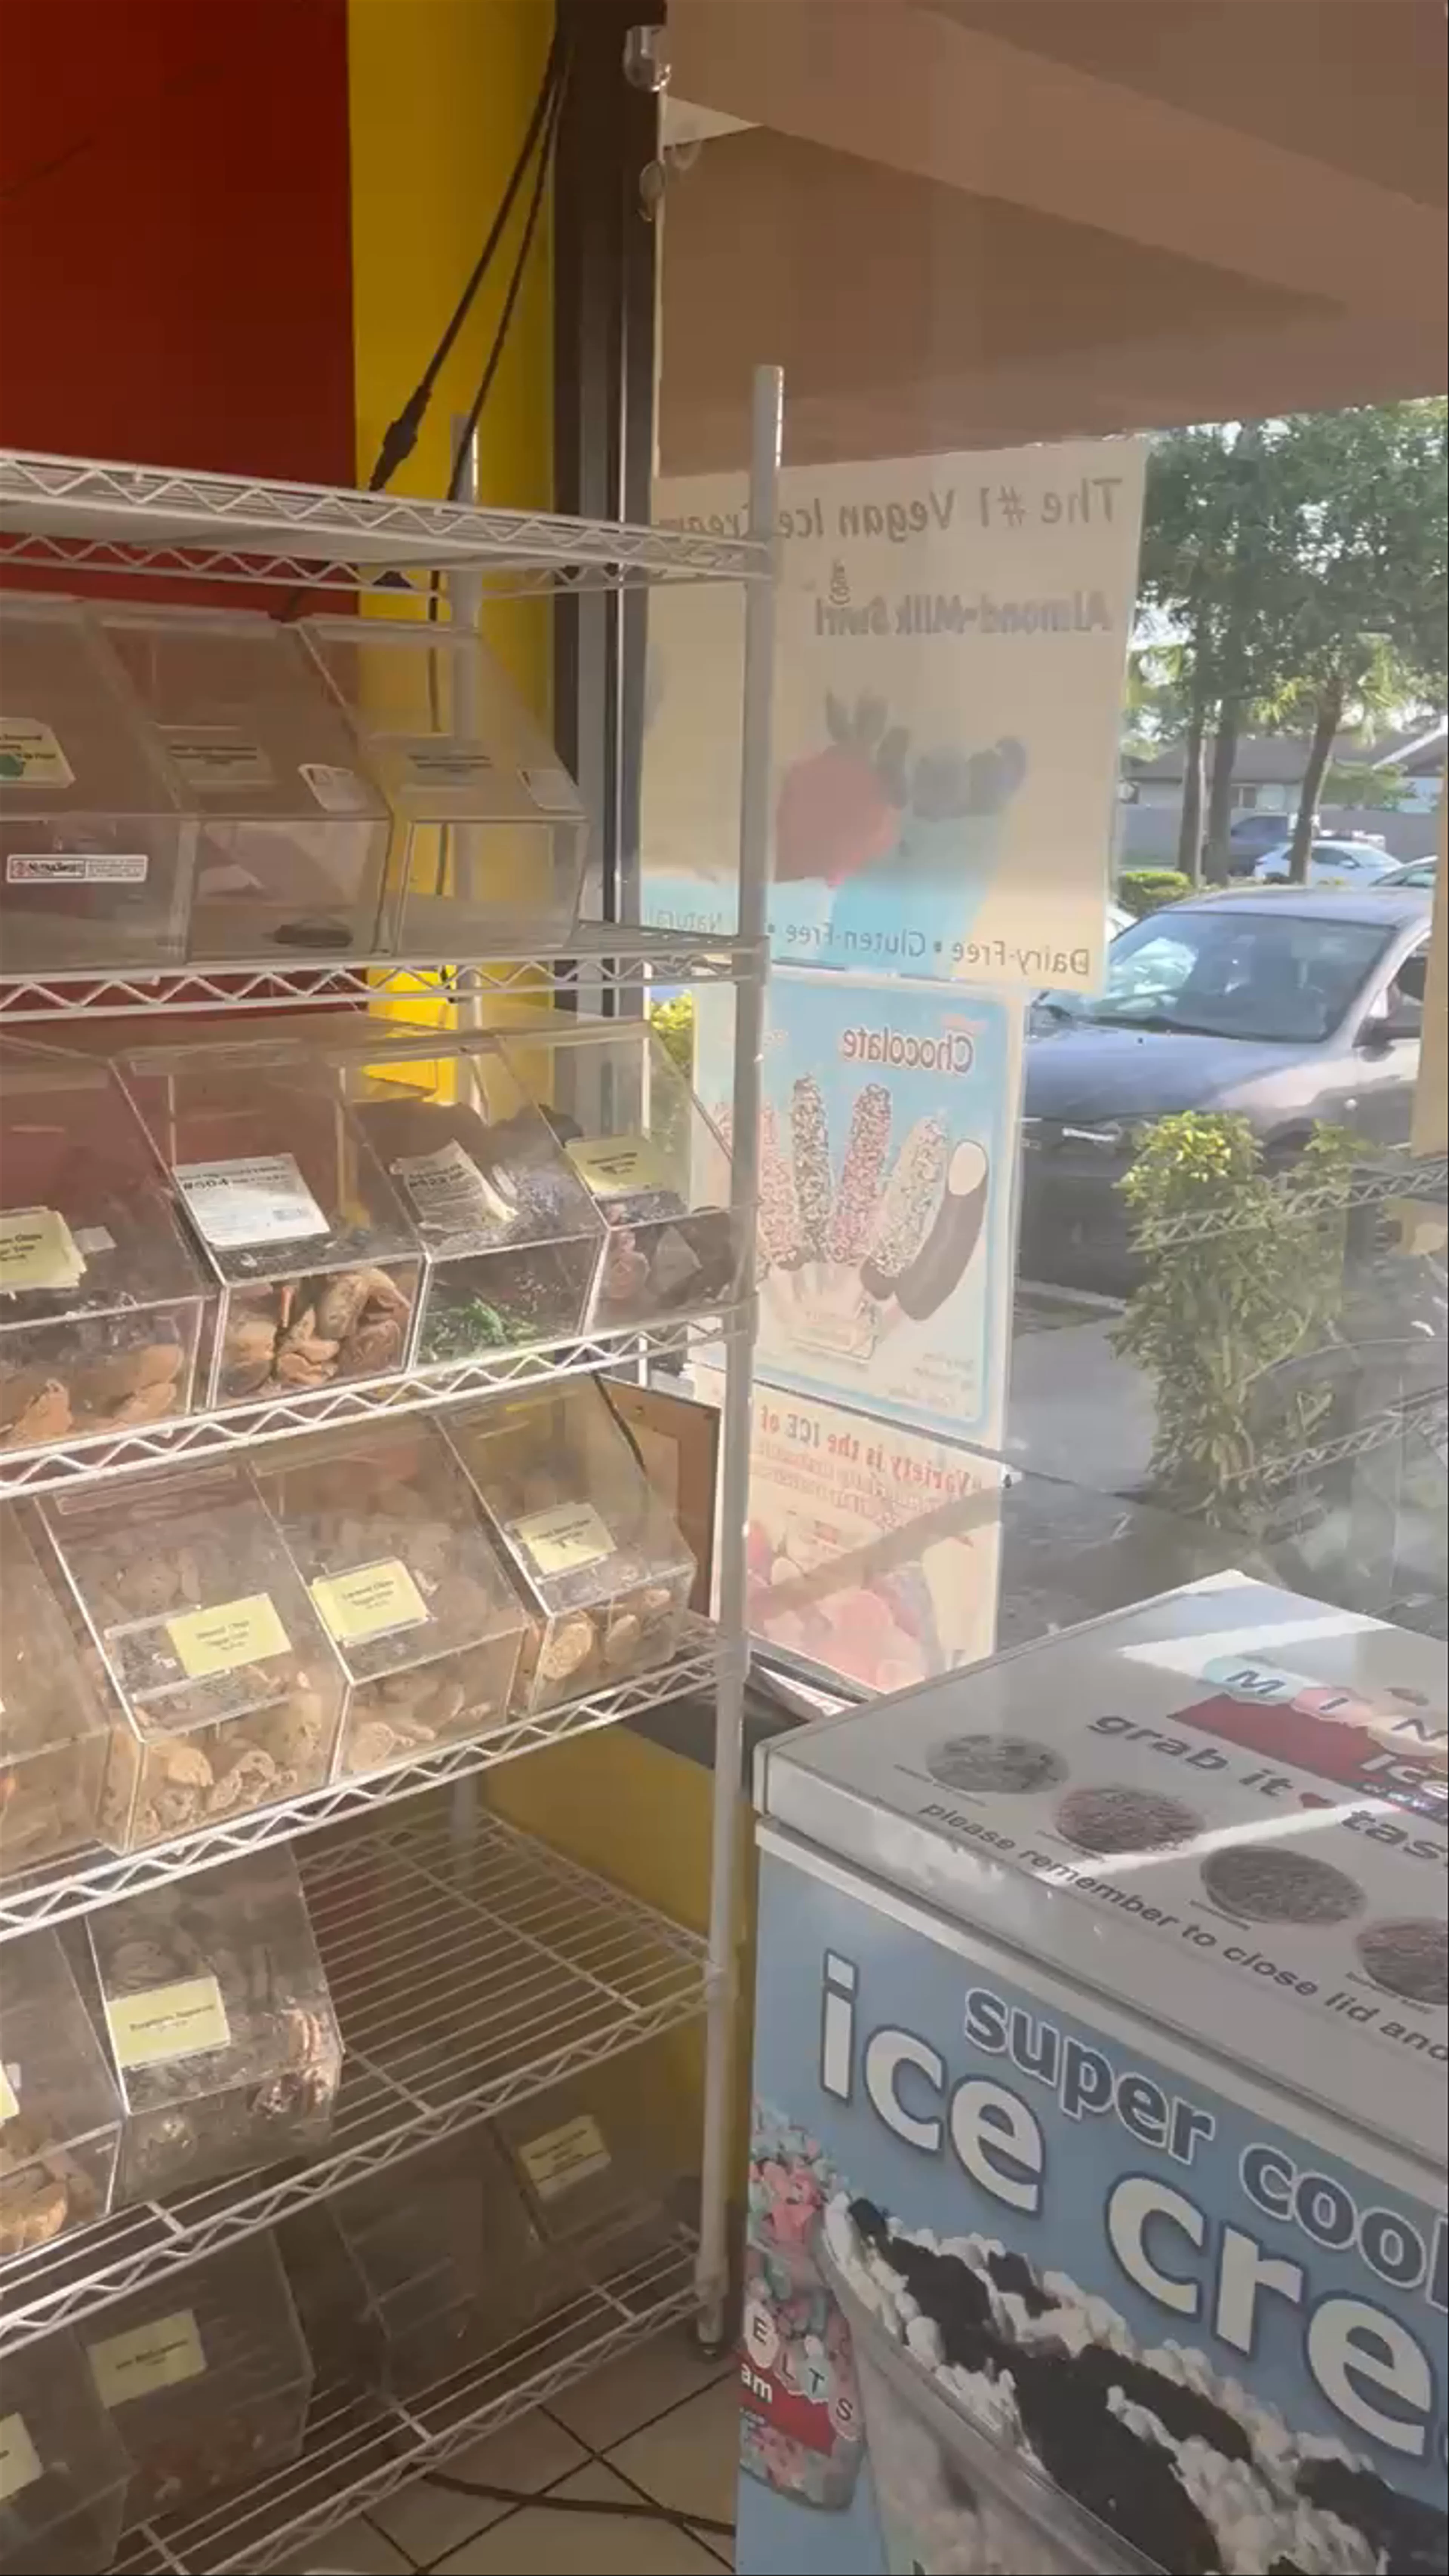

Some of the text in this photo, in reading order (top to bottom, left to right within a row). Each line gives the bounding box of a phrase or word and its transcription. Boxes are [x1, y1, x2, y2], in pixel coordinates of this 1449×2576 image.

[1087, 1715, 1229, 1770] grab
[1239, 1768, 1294, 1797] it
[1341, 1810, 1447, 1867] tas
[918, 1803, 1016, 1851] please
[1022, 1849, 1181, 1927] remember
[1183, 1922, 1217, 1947] to
[1223, 1944, 1319, 1998] close
[1324, 1992, 1380, 2022] lid
[964, 1987, 1214, 2164] super
[821, 1947, 1447, 2457] ice cre
